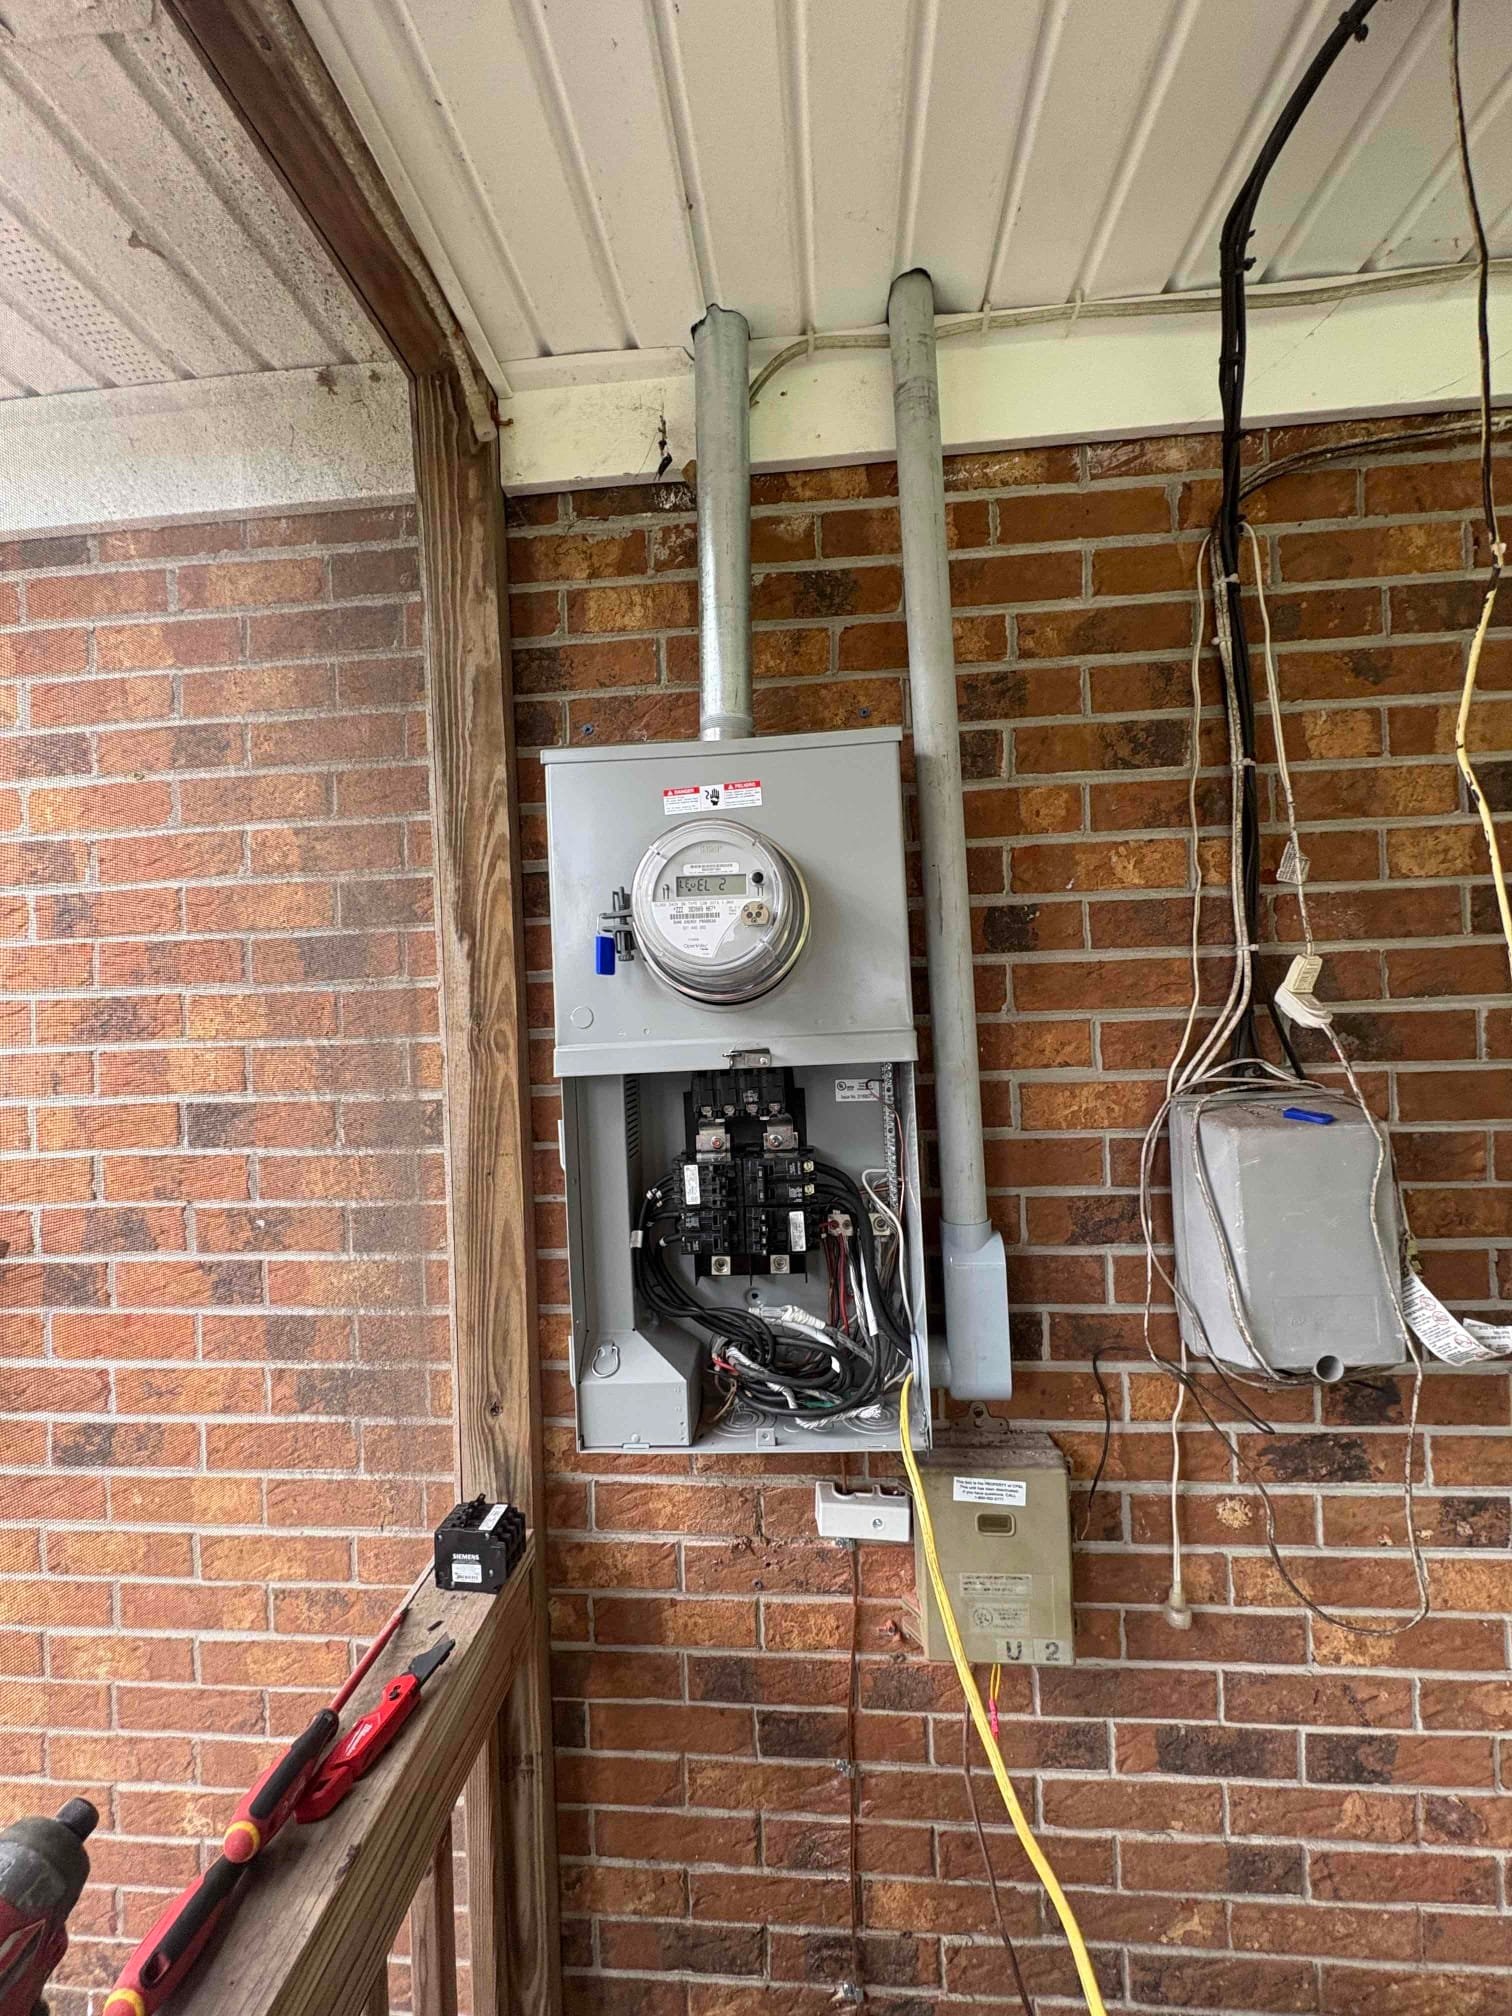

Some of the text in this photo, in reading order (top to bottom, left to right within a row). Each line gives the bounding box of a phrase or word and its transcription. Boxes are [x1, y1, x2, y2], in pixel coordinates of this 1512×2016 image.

[718, 877, 727, 891] 2
[452, 1553, 480, 1561] SIEMENS
[1006, 1641, 1060, 1661] U 2
